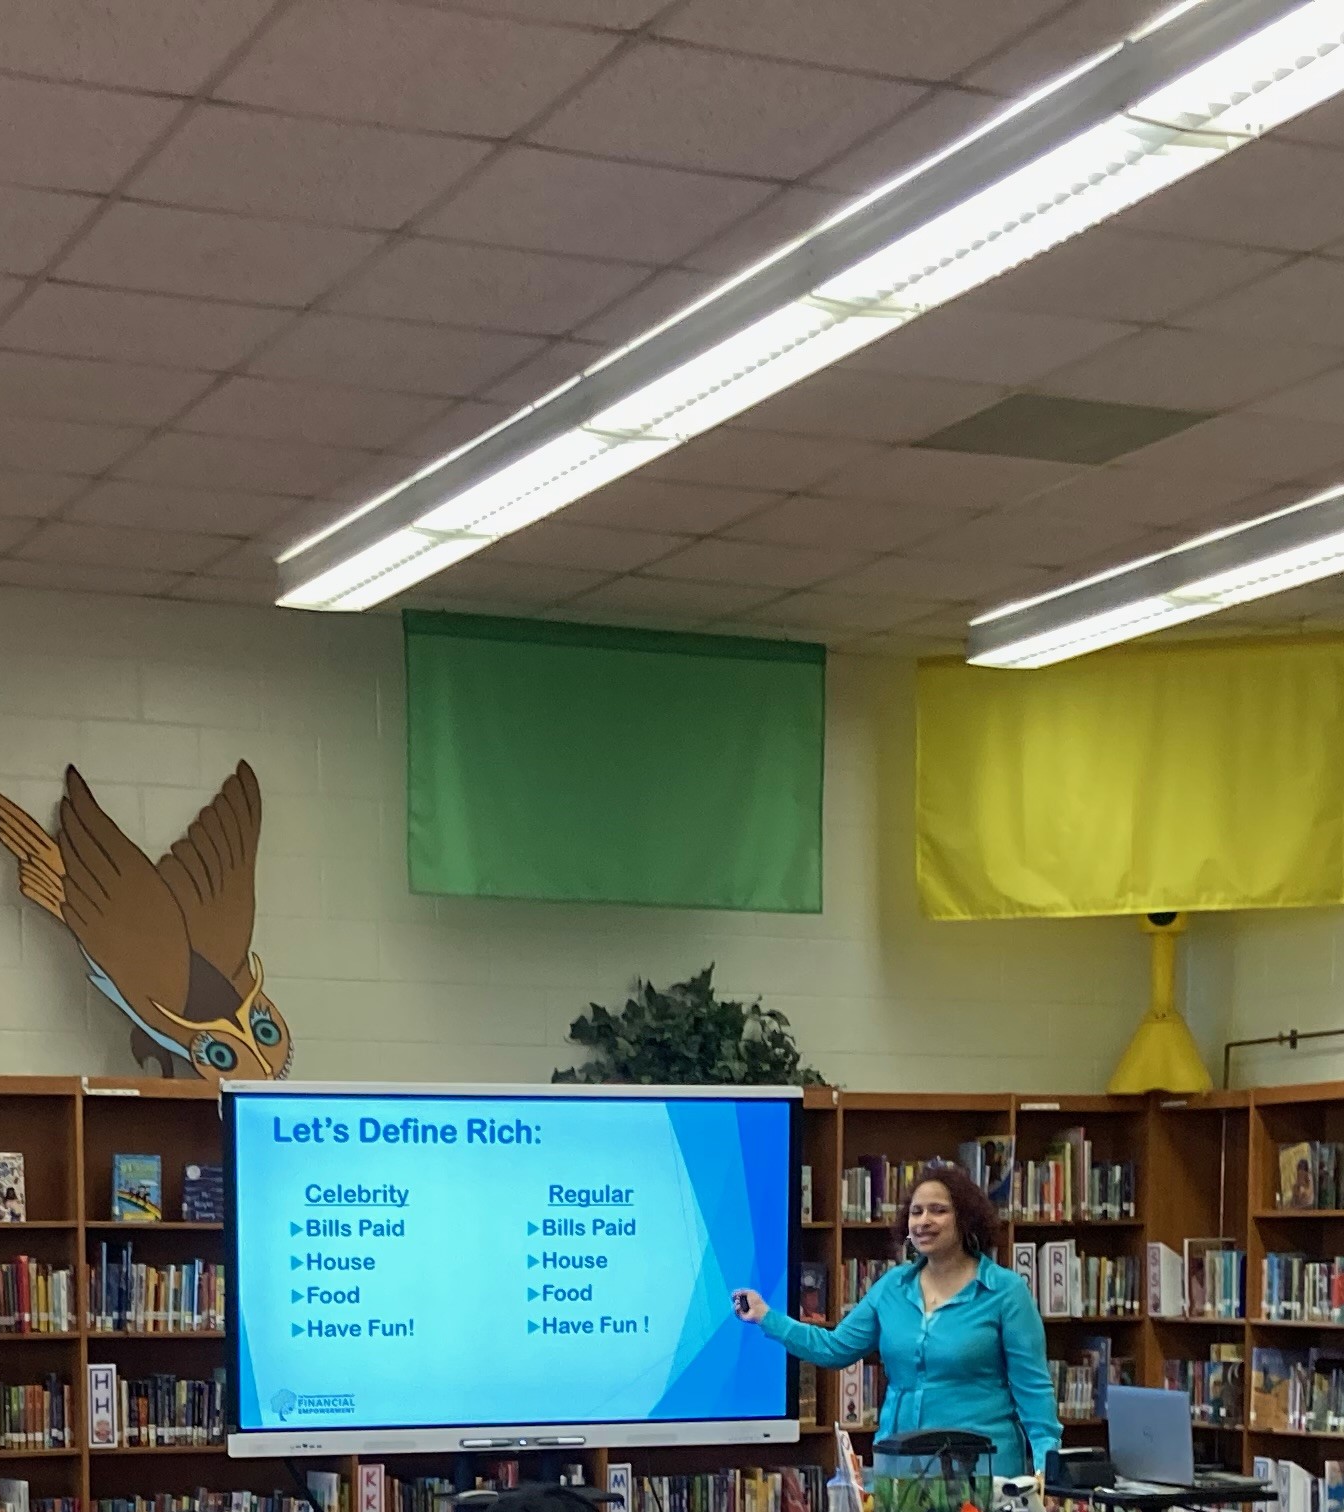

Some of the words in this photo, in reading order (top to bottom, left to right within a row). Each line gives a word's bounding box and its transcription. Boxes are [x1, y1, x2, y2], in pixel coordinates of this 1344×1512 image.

[273, 1116, 350, 1144] Let's
[359, 1117, 457, 1144] Define
[467, 1118, 541, 1145] Rich:
[305, 1184, 409, 1207] Celebrity
[549, 1184, 634, 1207] Regular
[306, 1219, 352, 1237] Bills
[358, 1218, 405, 1237] Paid
[542, 1218, 586, 1236] Bills
[592, 1218, 636, 1236] Paid
[306, 1252, 376, 1271] House
[542, 1251, 608, 1269] House
[307, 1286, 360, 1304] Food
[542, 1284, 592, 1301] Food
[308, 1319, 362, 1338] Have
[368, 1318, 414, 1337] Fun!
[542, 1316, 594, 1334] Have
[298, 1398, 355, 1407] FINANCIAL
